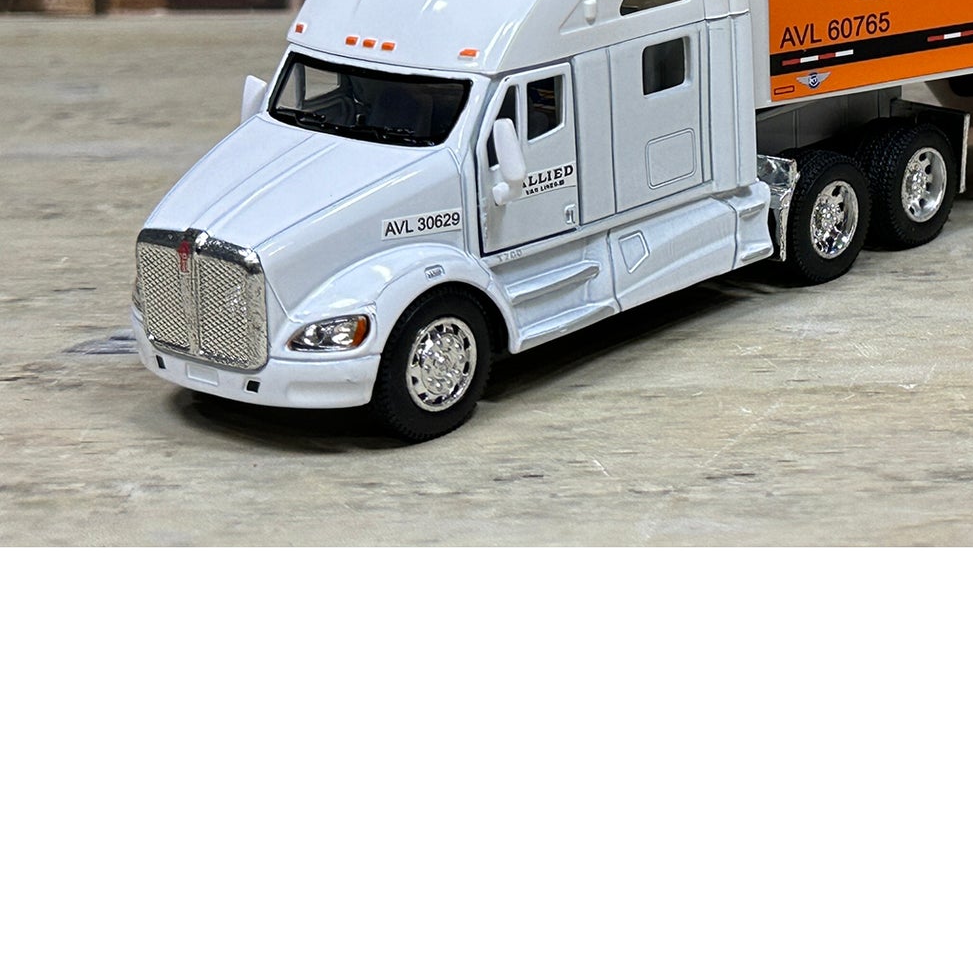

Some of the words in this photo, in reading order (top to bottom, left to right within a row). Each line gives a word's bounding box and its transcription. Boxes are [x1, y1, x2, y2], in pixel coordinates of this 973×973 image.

[780, 23, 822, 48] AVL
[828, 11, 890, 40] 60765
[384, 218, 413, 237] AVL
[417, 212, 460, 232] 30629
